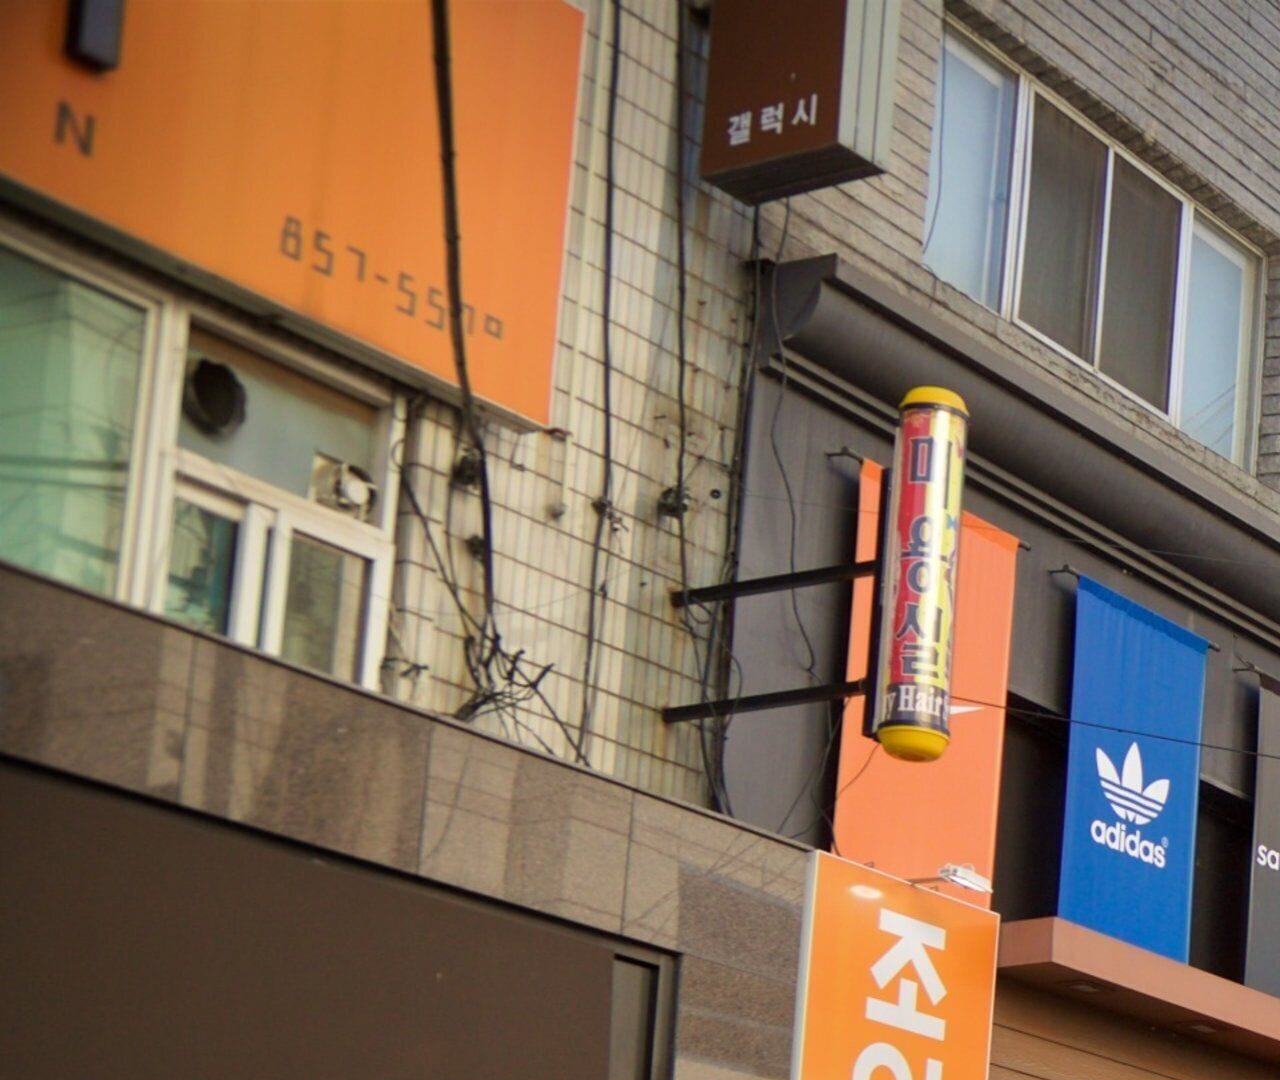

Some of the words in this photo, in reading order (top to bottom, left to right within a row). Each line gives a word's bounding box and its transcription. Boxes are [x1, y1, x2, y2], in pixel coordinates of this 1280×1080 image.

[727, 93, 818, 146] 갤럭시
[896, 436, 953, 679] 미용실
[1091, 818, 1168, 869] adidas
